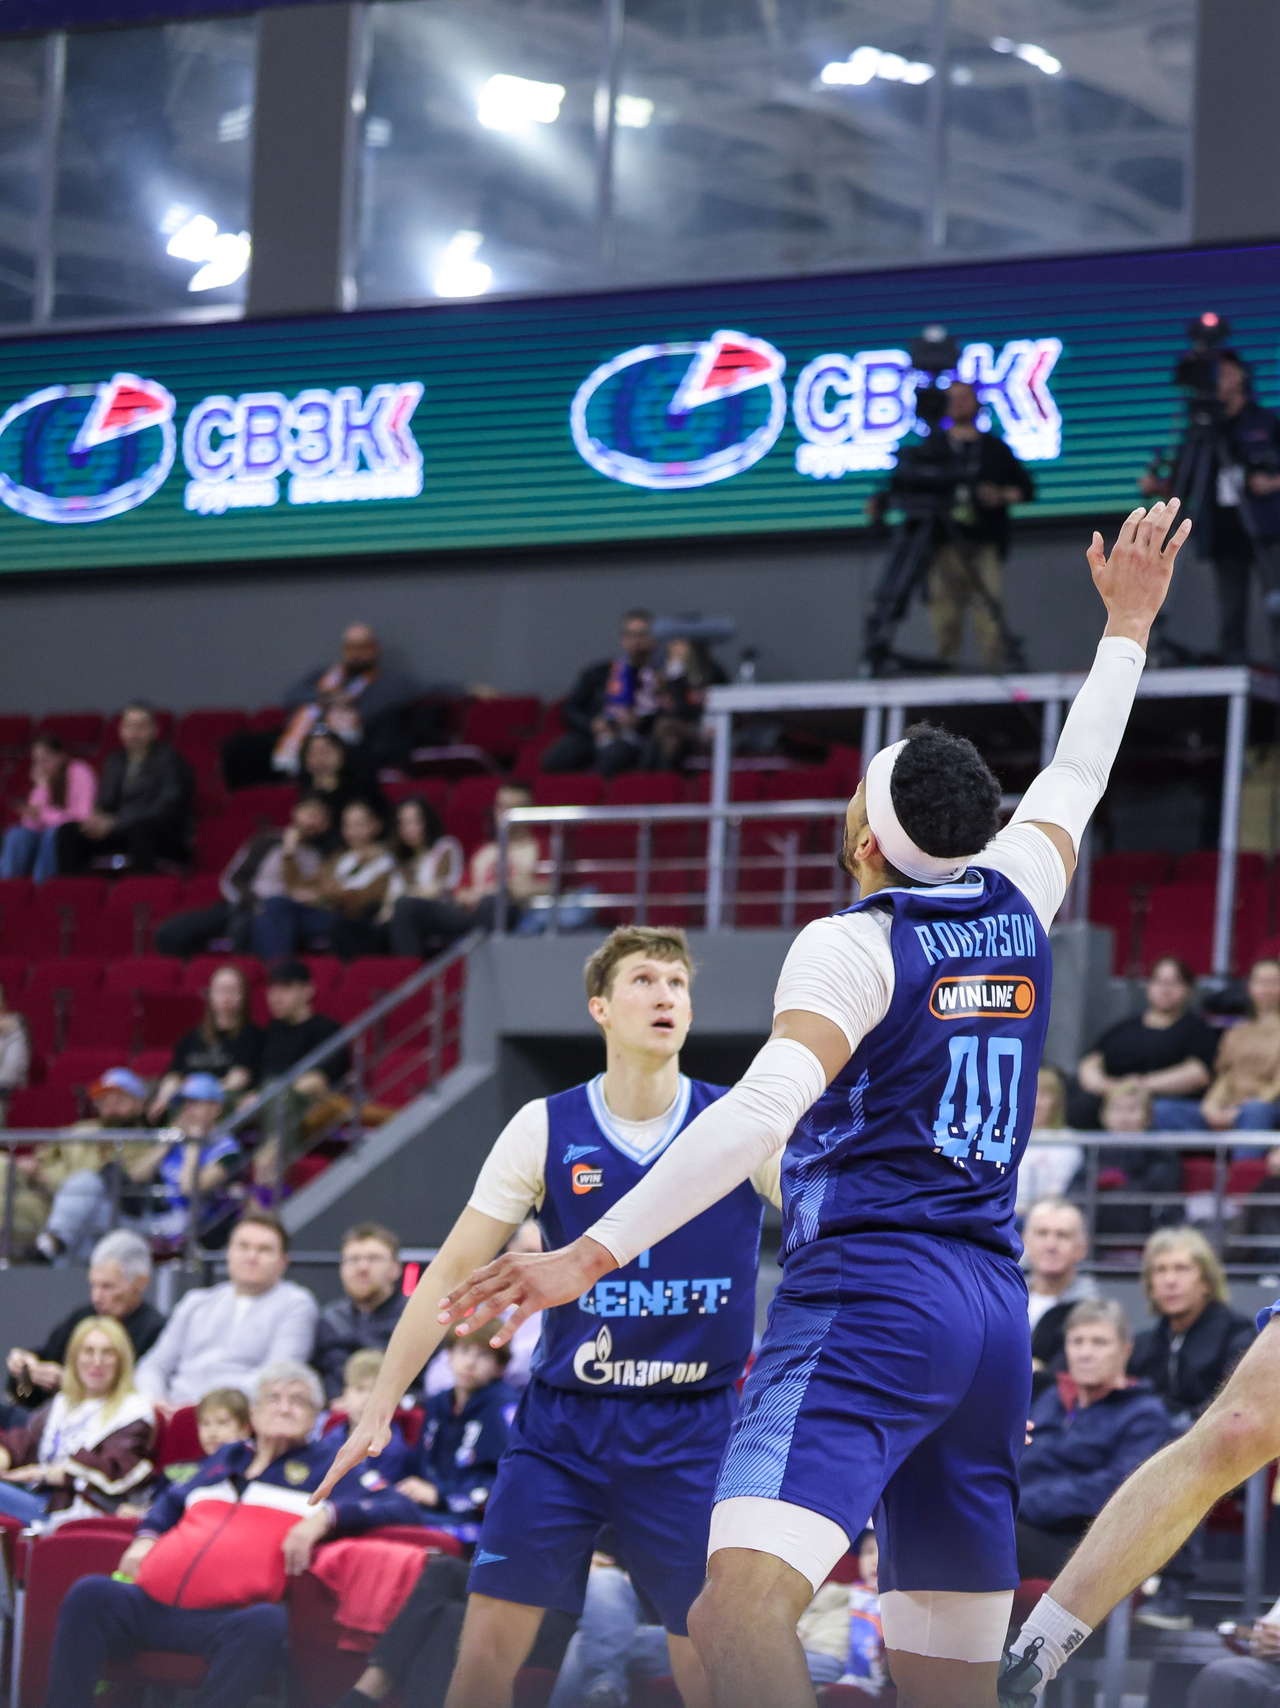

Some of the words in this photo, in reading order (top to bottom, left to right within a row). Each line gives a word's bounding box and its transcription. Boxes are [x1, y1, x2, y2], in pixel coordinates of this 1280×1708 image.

[794, 337, 1062, 446] СВК
[914, 914, 1036, 966] ROBERSON
[938, 985, 1014, 1011] WINLINE
[580, 1174, 602, 1184] WIN
[613, 1359, 709, 1387] ГАЗПРОМ
